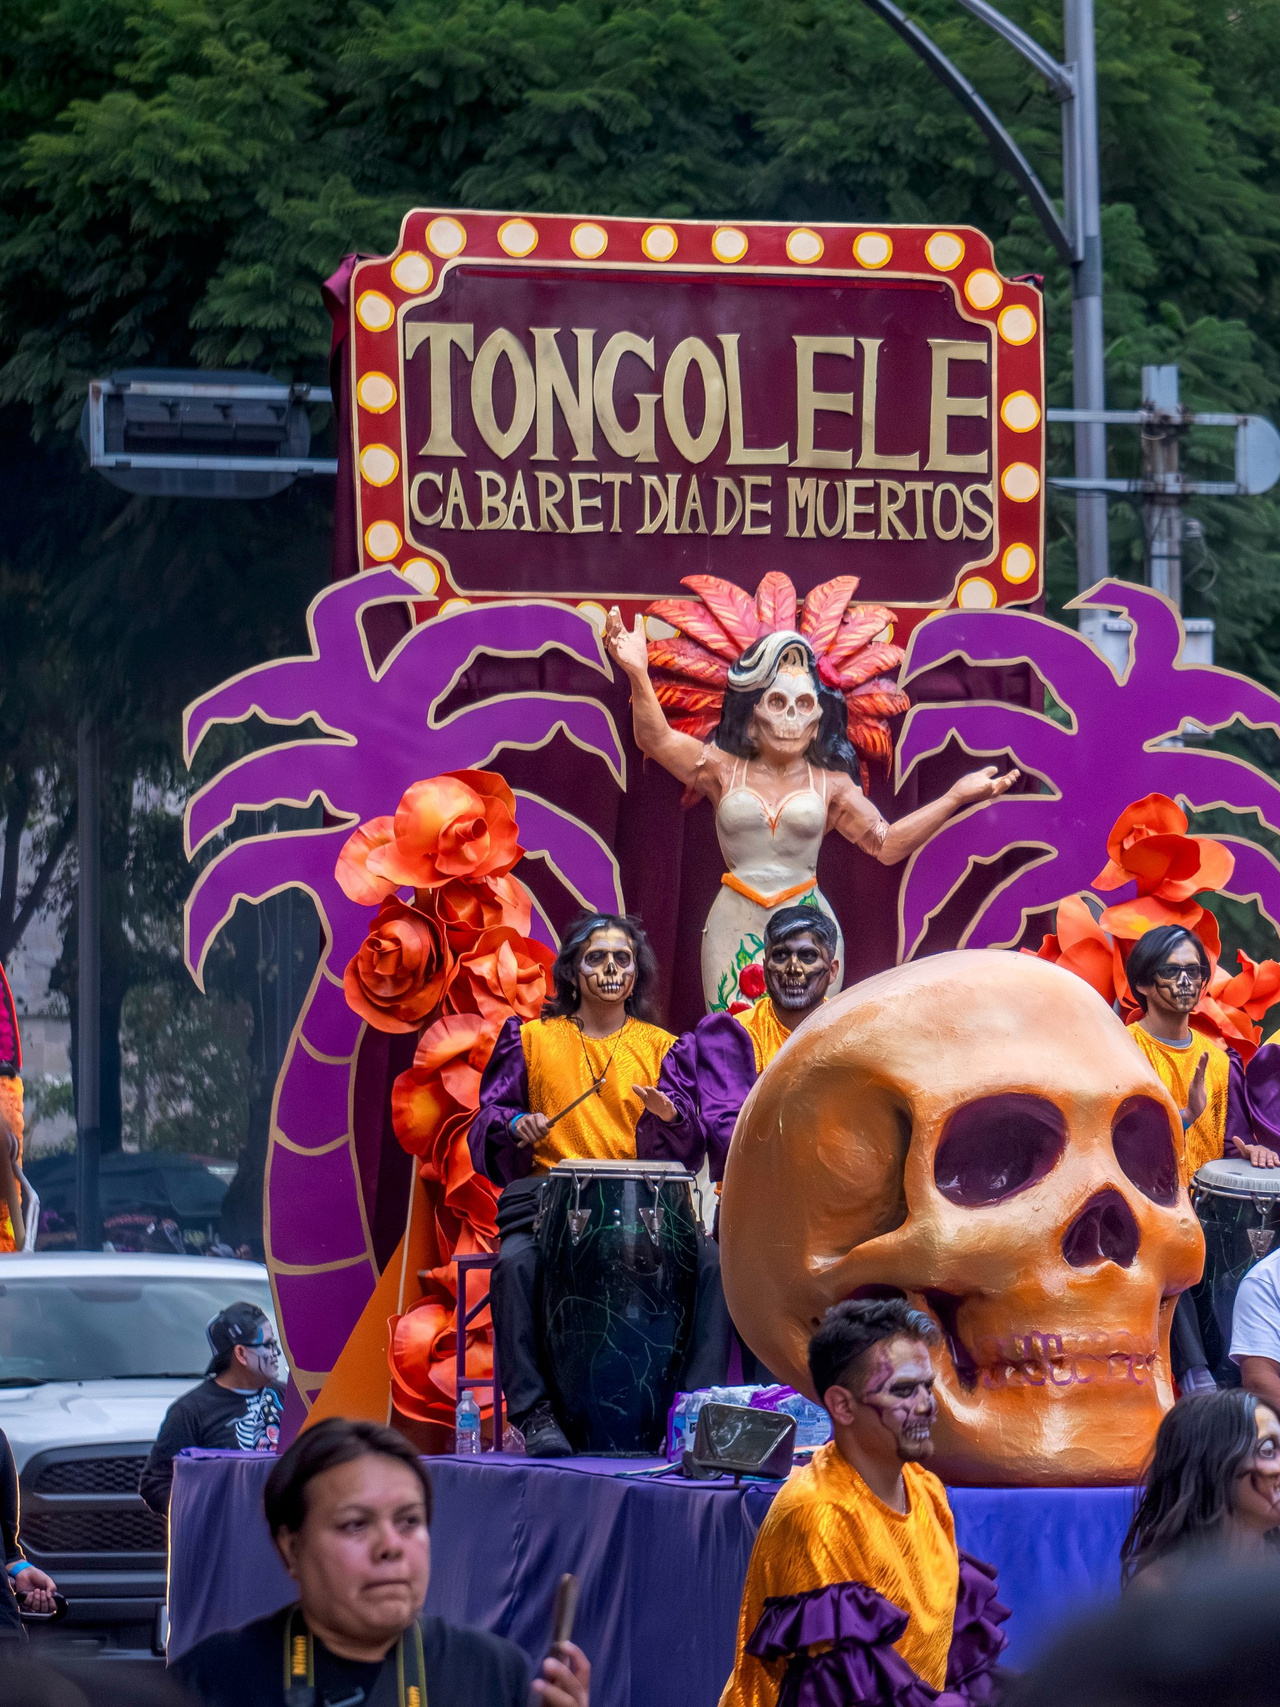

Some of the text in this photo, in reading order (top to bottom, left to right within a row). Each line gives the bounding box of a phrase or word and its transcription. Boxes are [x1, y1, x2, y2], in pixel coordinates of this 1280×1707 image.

[405, 322, 989, 474] TONGOLELE
[409, 467, 993, 541] CABARET DIA DE MUERTOS
[292, 1635, 307, 1676] Nikon
